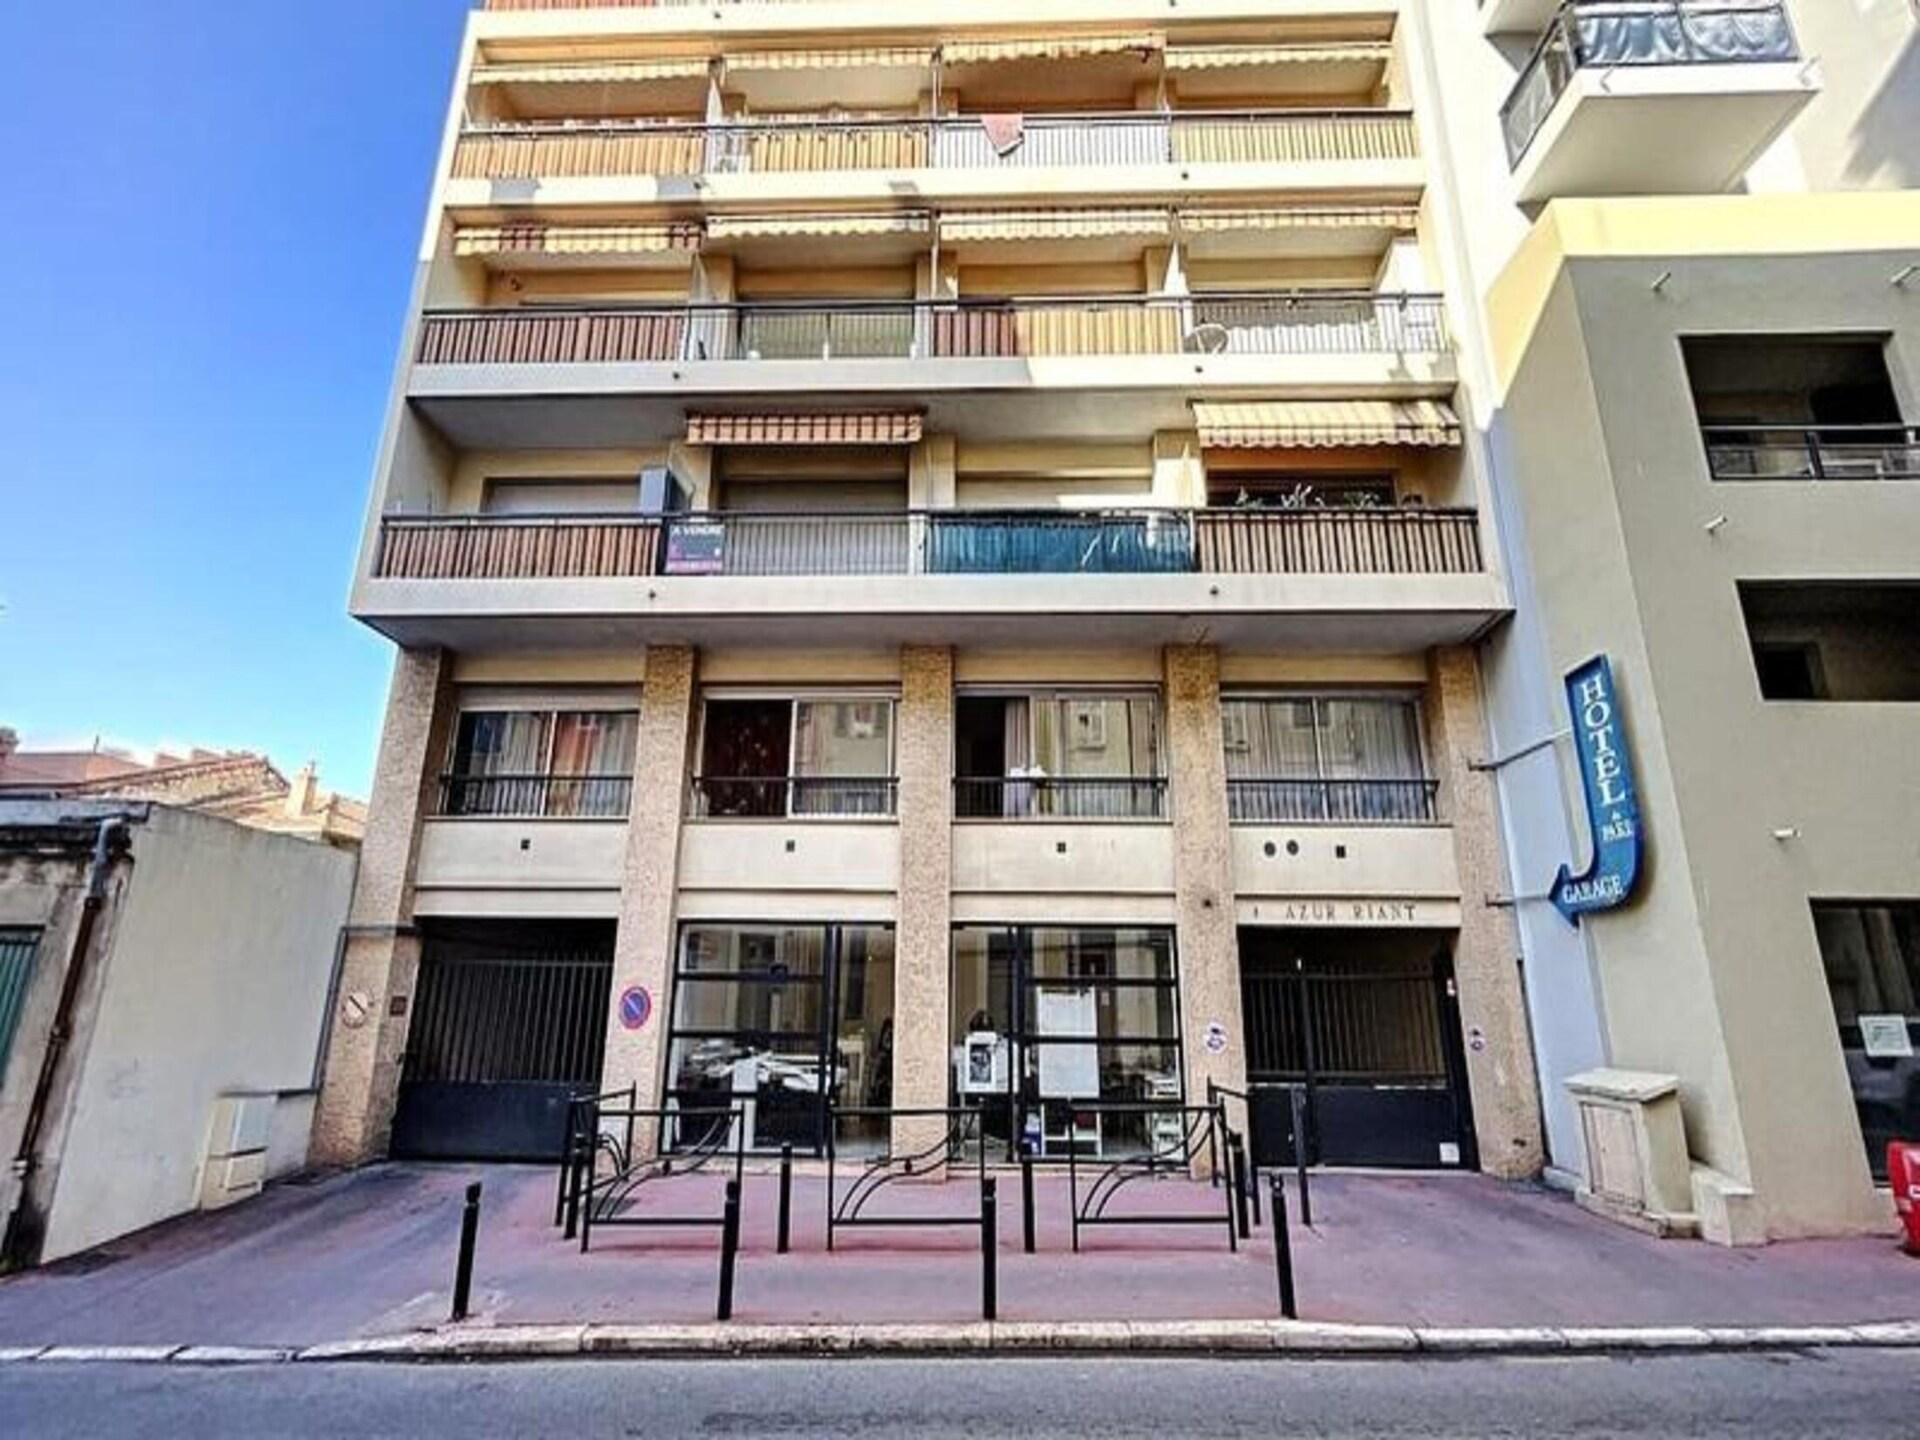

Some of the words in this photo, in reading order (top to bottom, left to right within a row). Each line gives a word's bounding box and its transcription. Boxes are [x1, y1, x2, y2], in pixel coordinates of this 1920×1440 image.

[1580, 674, 1626, 806] HOTEL
[1561, 874, 1624, 904] GARAGE
[1285, 902, 1336, 920] AZUR
[1352, 904, 1417, 921] RIANT
